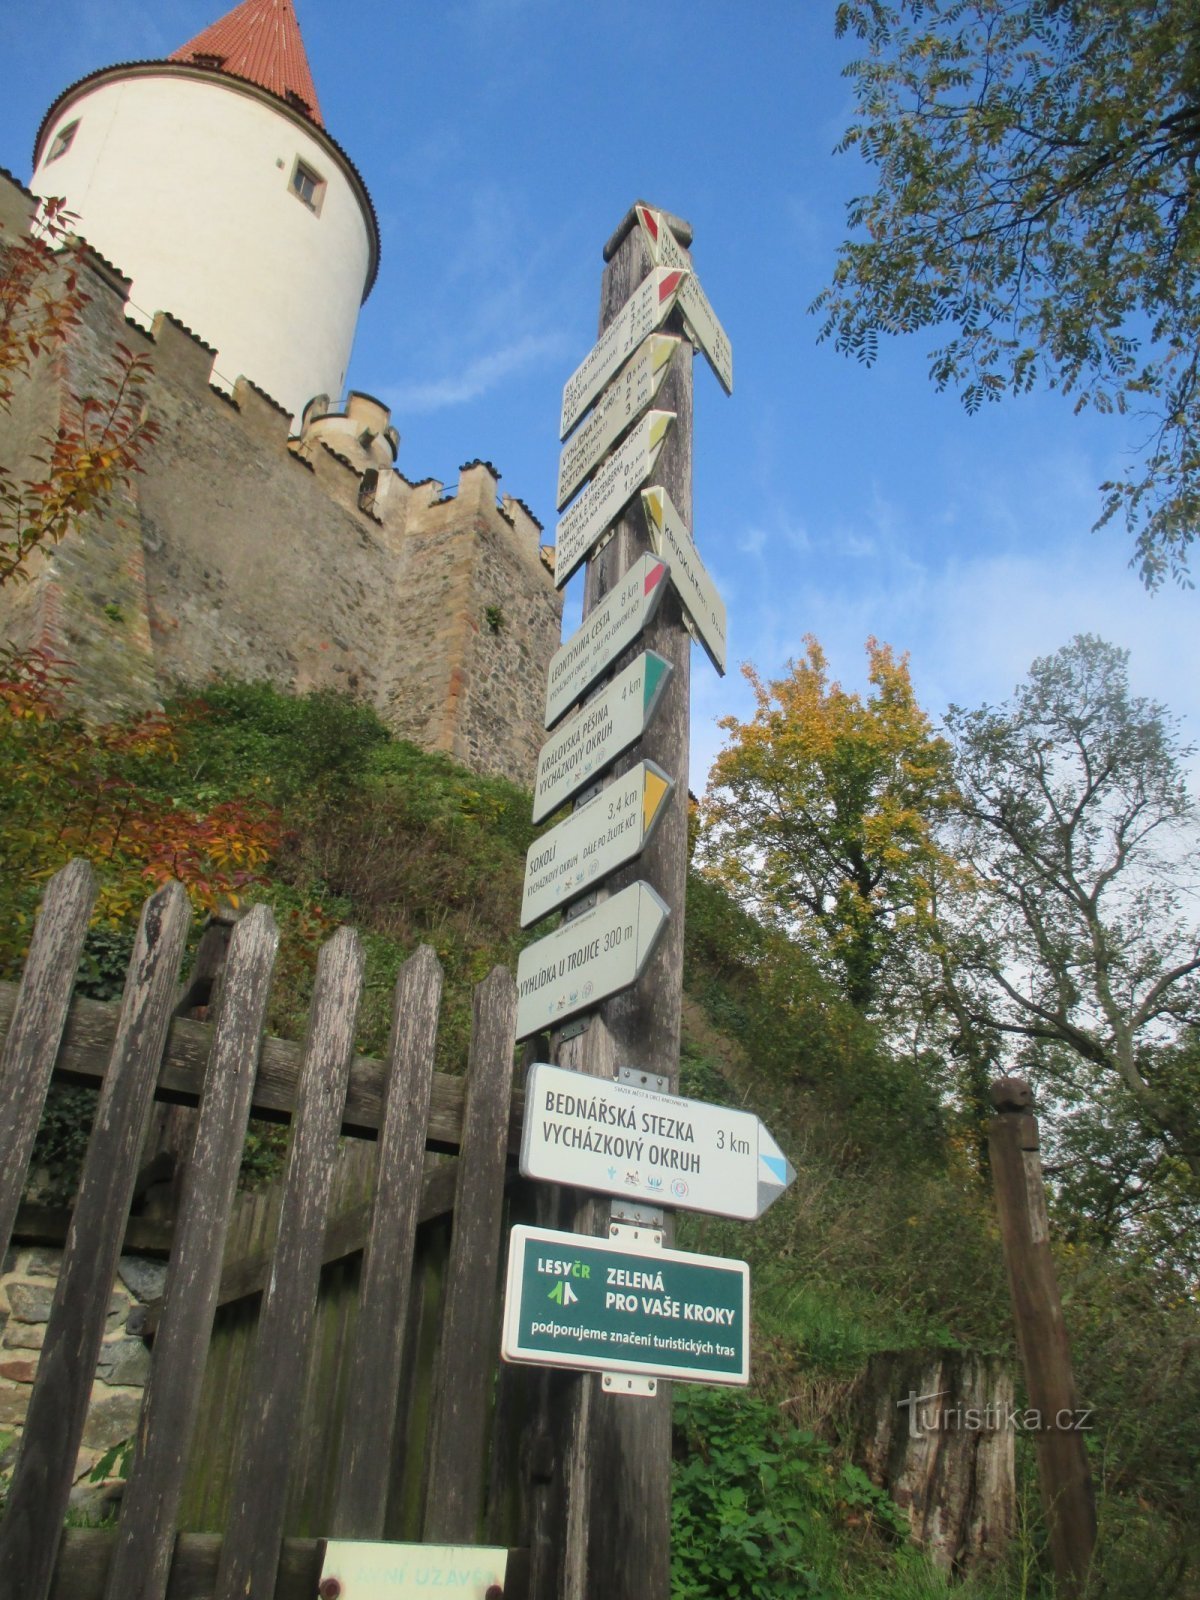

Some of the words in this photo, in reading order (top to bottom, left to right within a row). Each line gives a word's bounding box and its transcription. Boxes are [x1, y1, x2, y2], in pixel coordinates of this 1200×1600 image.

[551, 633, 590, 684] LEONTÝNINA
[591, 610, 611, 639] CESTA
[620, 592, 627, 607] 8
[627, 581, 639, 599] km
[539, 743, 584, 796] VYCHÁZKOVÝ
[585, 720, 613, 755] OKRUH
[541, 725, 580, 776] KRÁLOVSKÁ
[582, 704, 609, 739] PĚŠINA
[621, 686, 627, 700] 4
[629, 678, 641, 695] km
[527, 866, 559, 897] VYCHÁZKOVÝ
[559, 852, 579, 875] OKRUH
[583, 840, 597, 859] DÁLE
[597, 834, 606, 848] PO
[607, 818, 625, 842] ŽLUTÉ
[625, 812, 637, 829] KČT
[529, 840, 557, 876] SOKOLÍ
[607, 796, 622, 820] 3,4
[624, 790, 637, 808] km
[520, 964, 557, 998] VYHLÍDKA
[559, 958, 566, 977] U
[567, 938, 600, 972] TROJICE
[603, 926, 622, 952] 300
[624, 925, 633, 941] m
[543, 1121, 644, 1161] VYCHÁZKOVÝ
[648, 1144, 701, 1174] OKRUH
[545, 1090, 637, 1130] BEDNÁŘSKÁ
[642, 1113, 695, 1143] STEZKA
[716, 1130, 725, 1149] 3
[729, 1131, 750, 1155] km
[605, 1292, 638, 1313] PRO
[642, 1295, 680, 1319] VAŠE
[684, 1303, 735, 1326] KROKY
[606, 1267, 665, 1292] ZELENÁ
[531, 1321, 608, 1342] podporujeme
[609, 1327, 651, 1346] značení
[653, 1335, 714, 1356] turistických
[715, 1343, 735, 1357] tras
